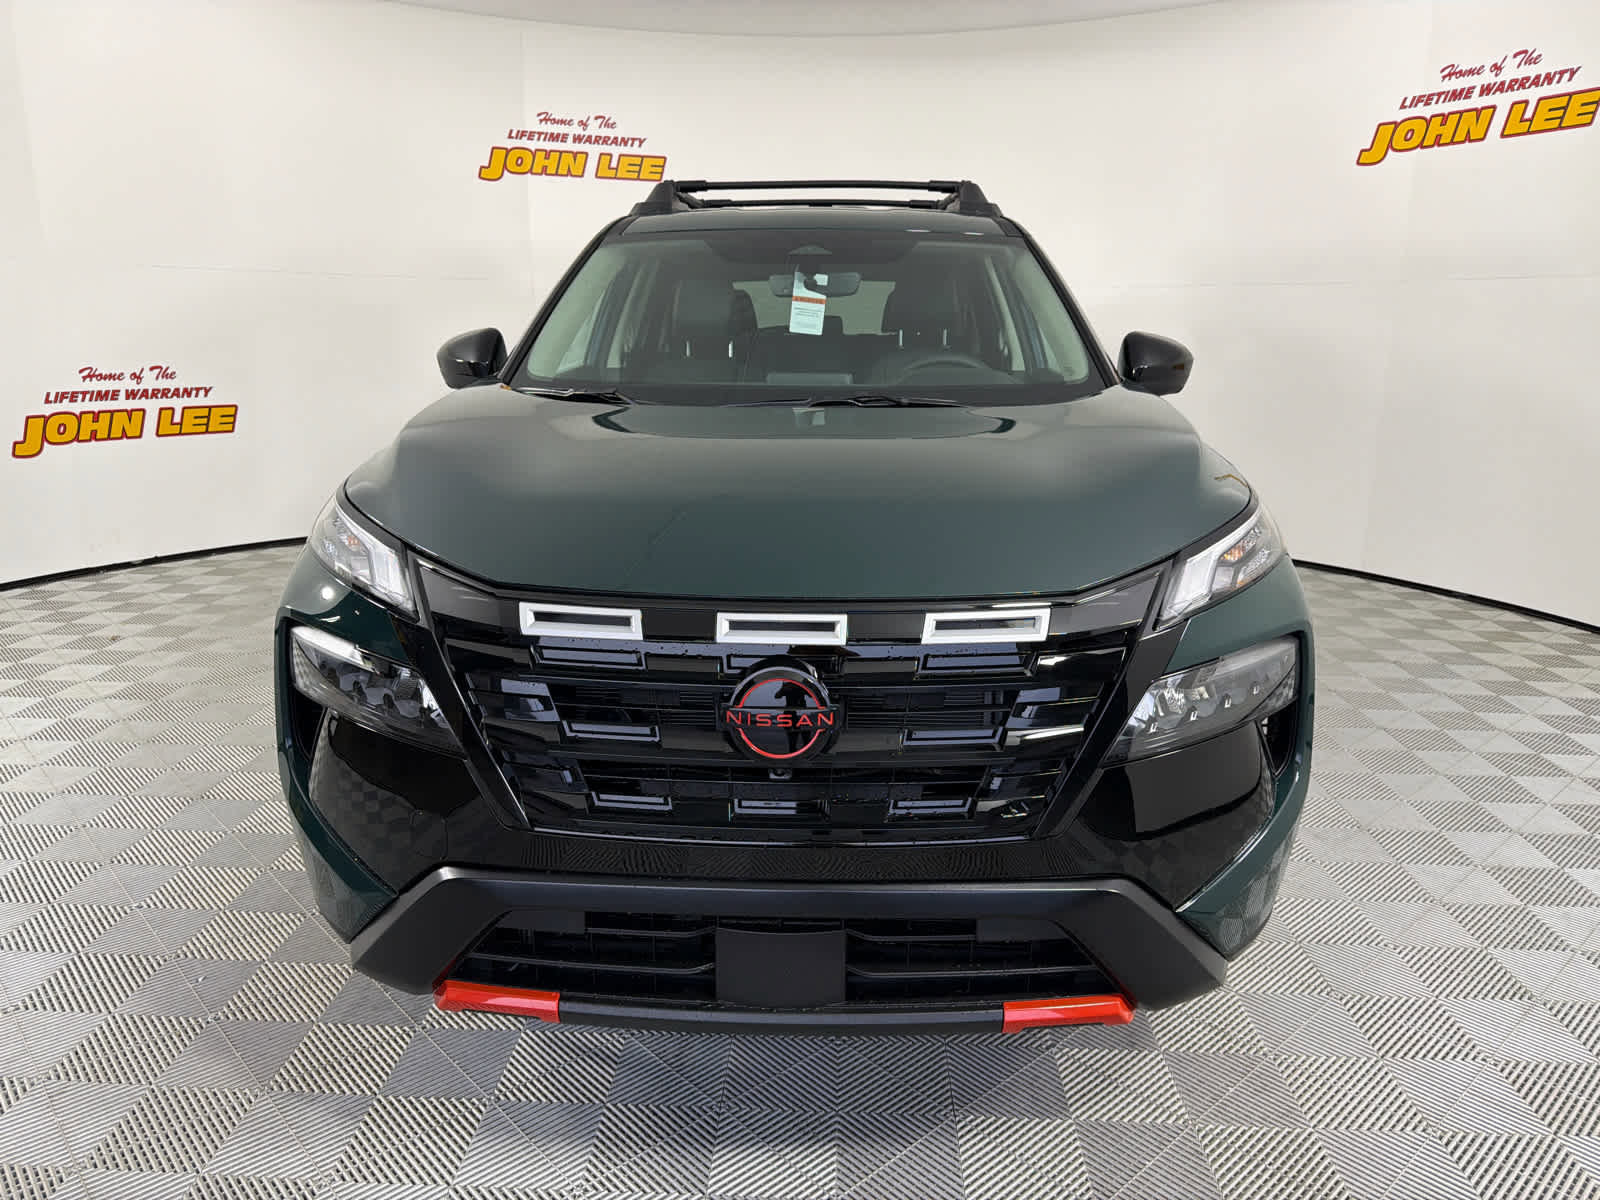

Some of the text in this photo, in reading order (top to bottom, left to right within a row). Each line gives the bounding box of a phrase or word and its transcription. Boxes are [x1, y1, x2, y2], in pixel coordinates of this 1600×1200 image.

[1440, 48, 1543, 82] Home of The
[1399, 66, 1581, 110] LIFETIME WARRANTY
[537, 112, 616, 131] Home of The
[1356, 87, 1600, 166] JOHN LEE
[507, 129, 648, 148] LIFETIME WARRANTY
[479, 146, 667, 181] JOHN LEE
[78, 365, 176, 385] Home of The
[44, 386, 213, 404] LIFETIME WARRANTY
[12, 404, 238, 458] JOHN LEE
[726, 710, 833, 727] NISSAN
